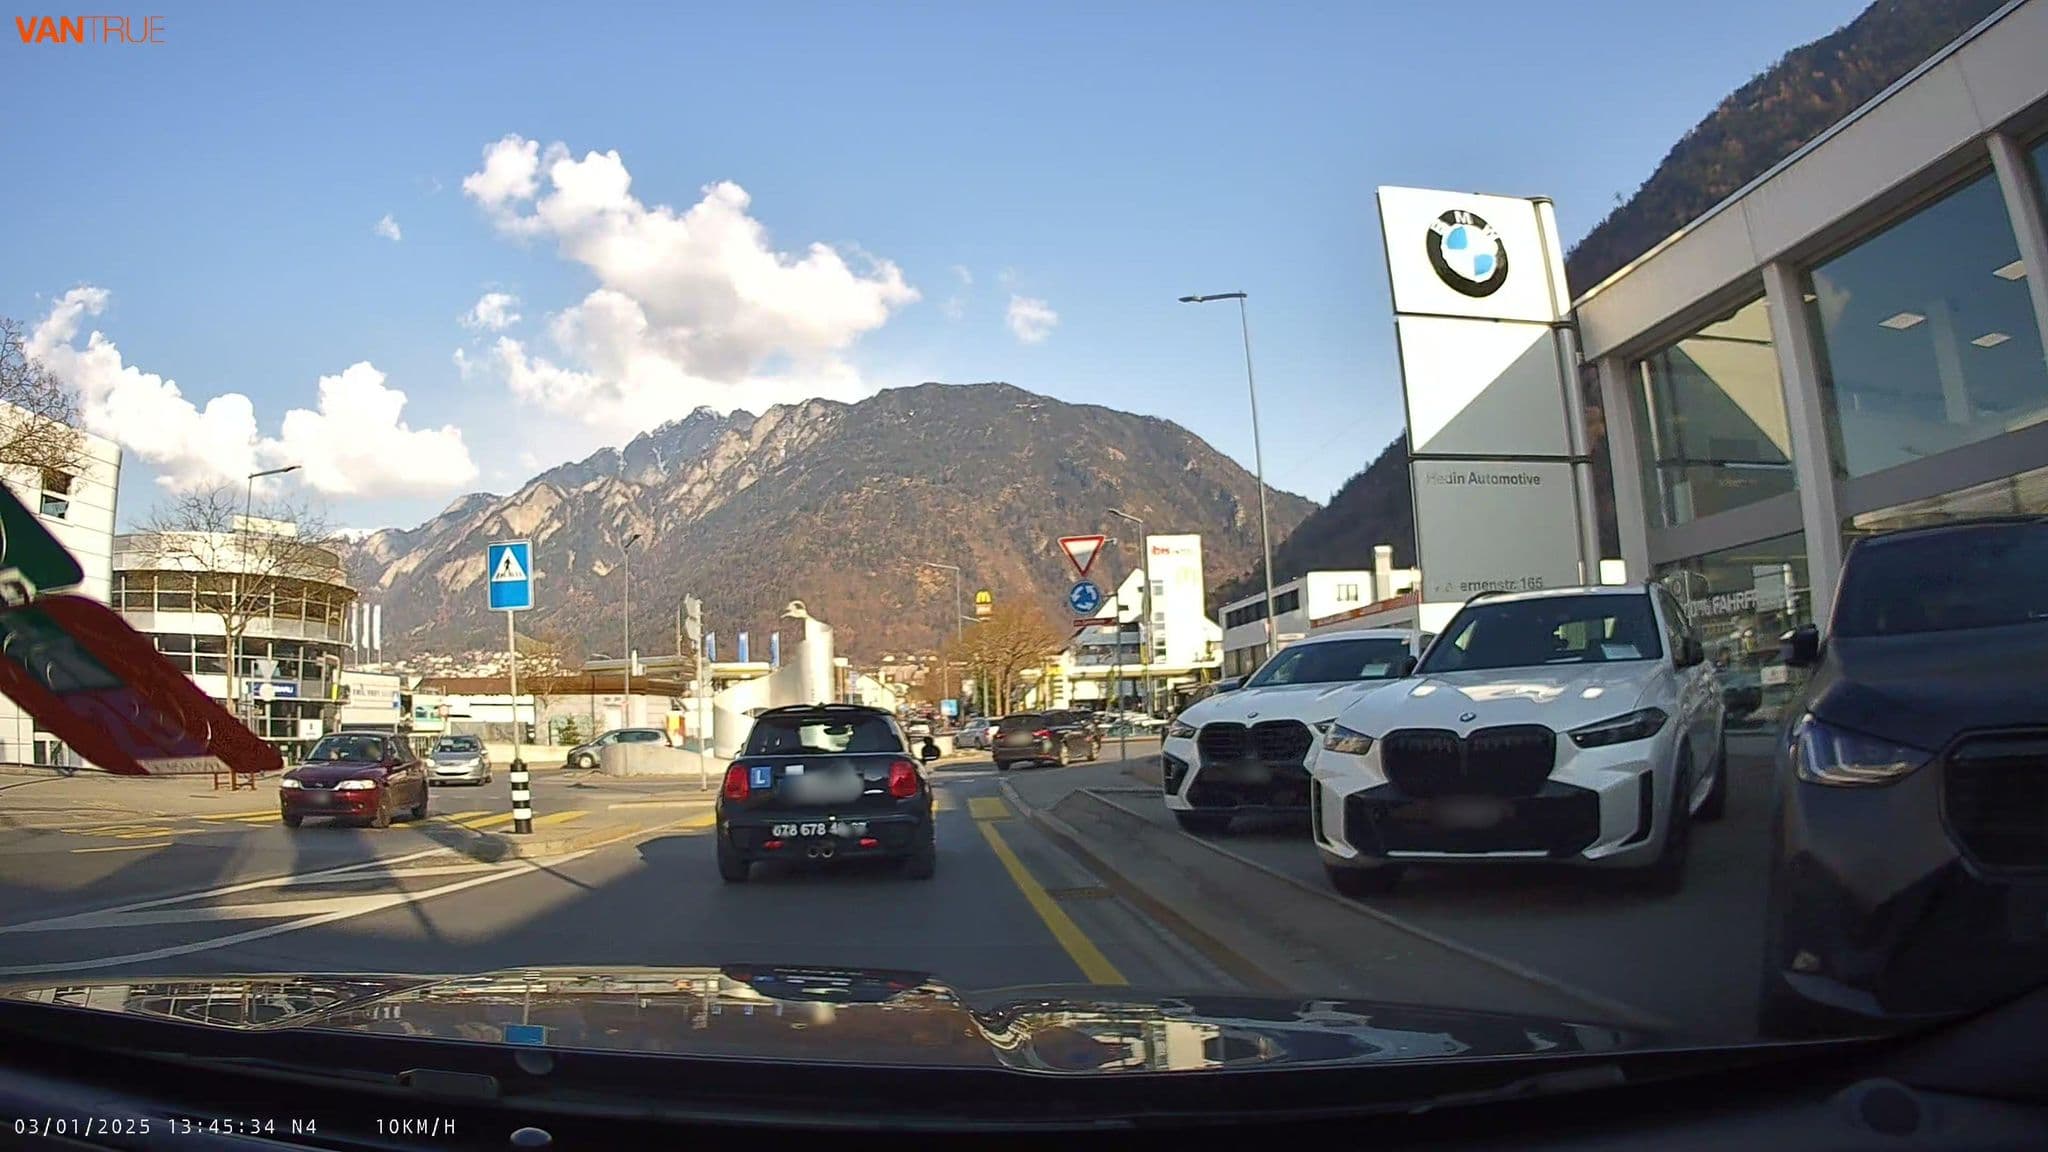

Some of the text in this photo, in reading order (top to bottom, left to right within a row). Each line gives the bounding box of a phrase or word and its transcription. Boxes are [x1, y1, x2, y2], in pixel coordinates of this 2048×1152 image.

[1468, 472, 1541, 486] Automotive
[1520, 577, 1543, 590] 165
[755, 769, 766, 785] L
[800, 822, 826, 836] 678
